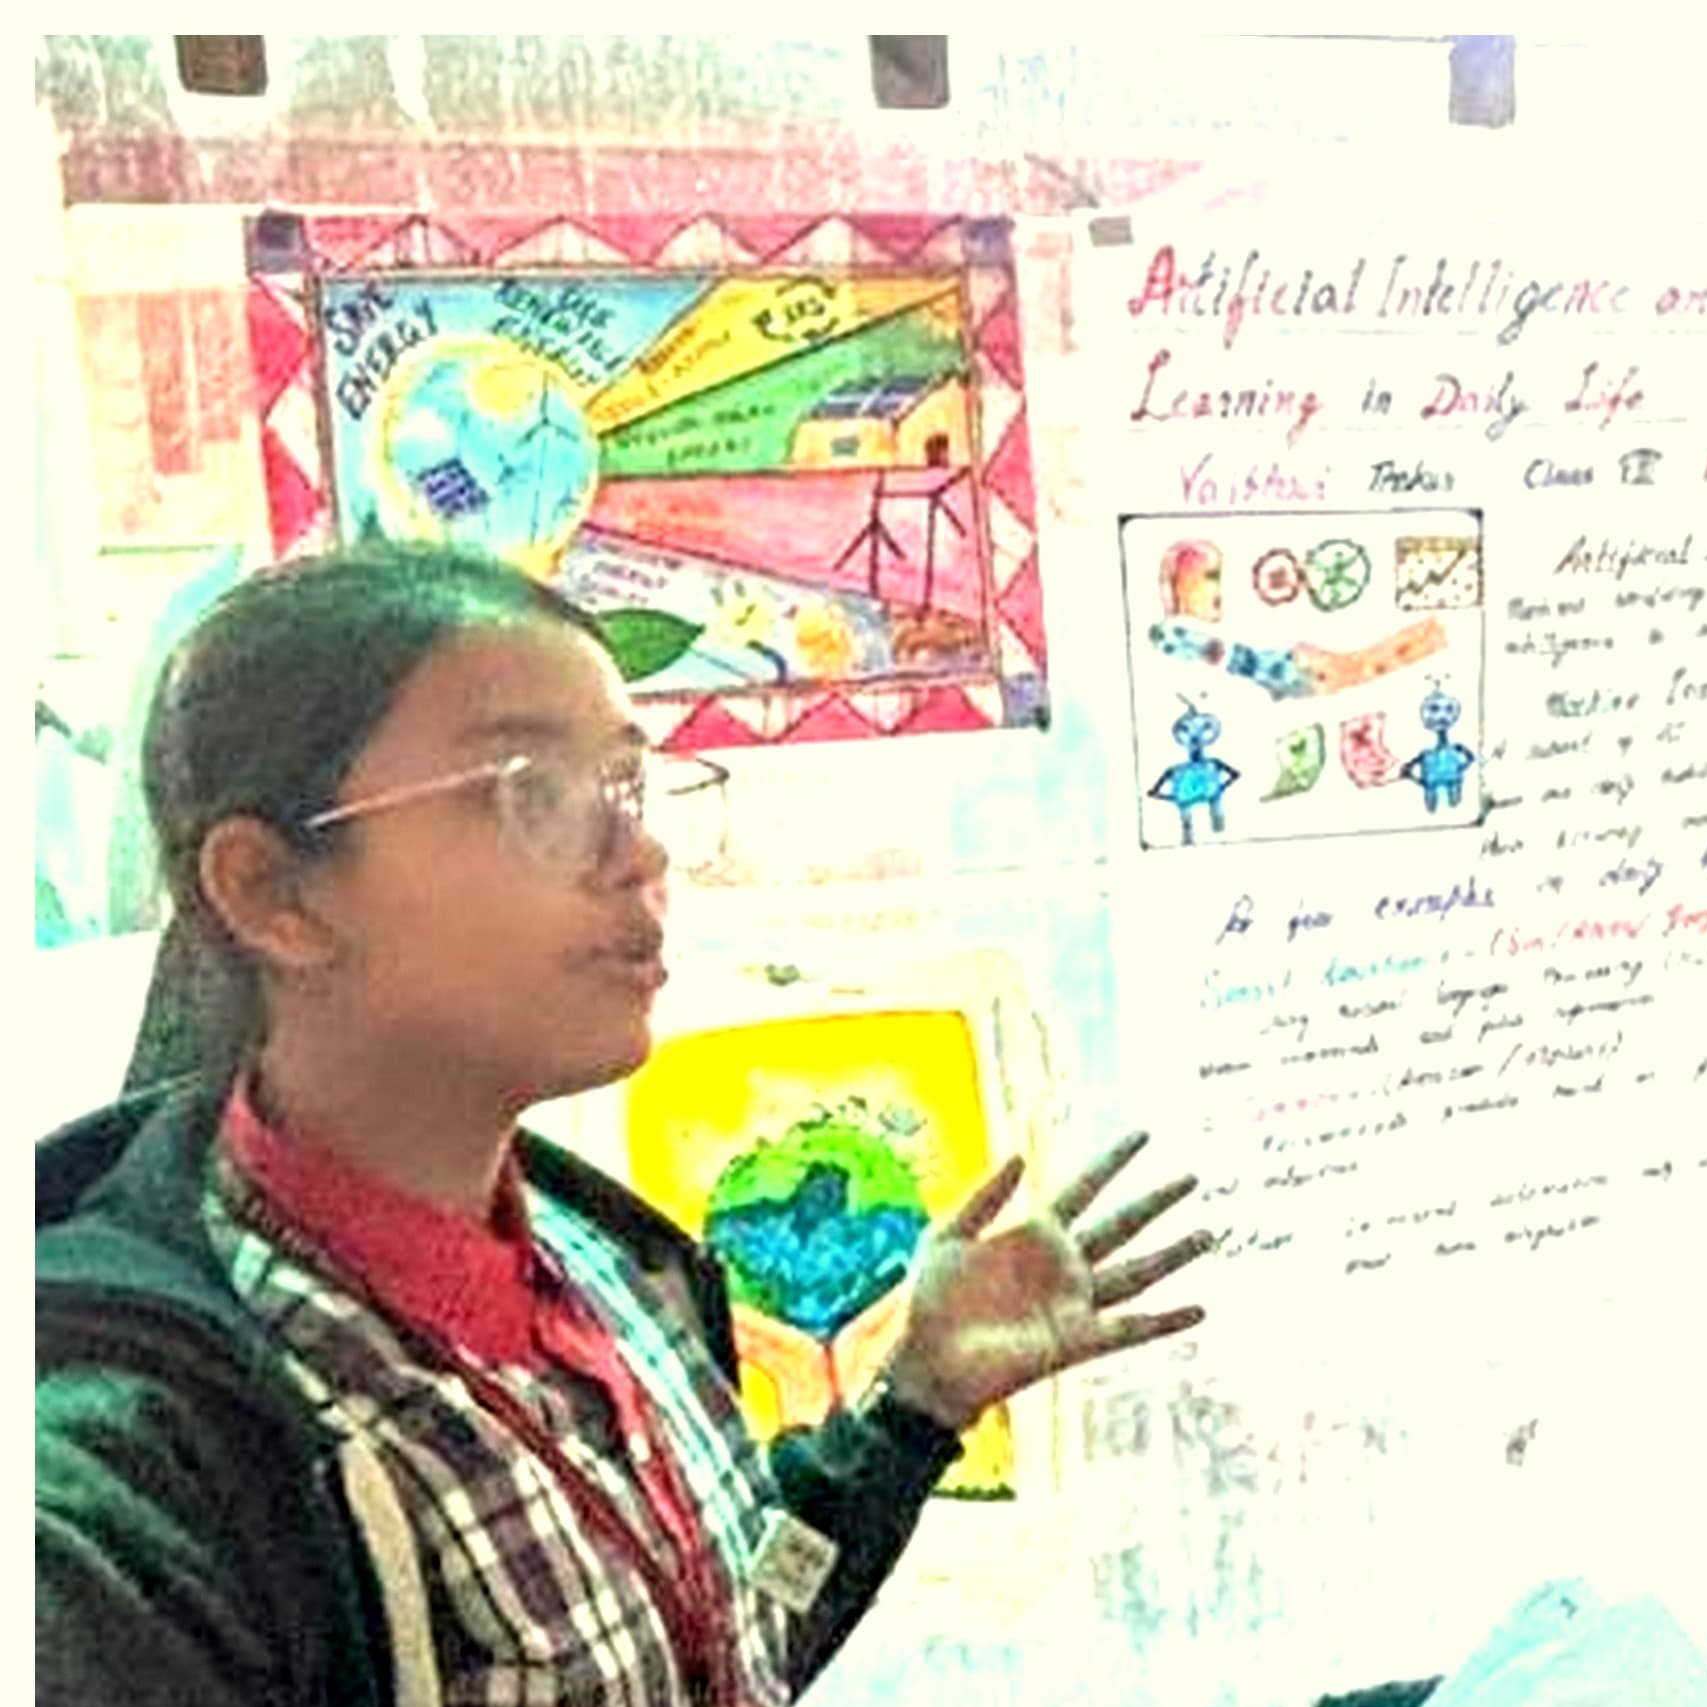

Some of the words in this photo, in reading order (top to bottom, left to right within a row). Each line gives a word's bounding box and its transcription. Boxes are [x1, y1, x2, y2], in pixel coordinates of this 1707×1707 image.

[1127, 244, 1367, 350] Artificial
[1376, 252, 1630, 346] Intelligence
[335, 297, 438, 422] ENERGY
[1129, 348, 1325, 450] Learning
[1361, 377, 1393, 415] in
[1419, 372, 1530, 443] Daily
[1564, 360, 1645, 431] Life
